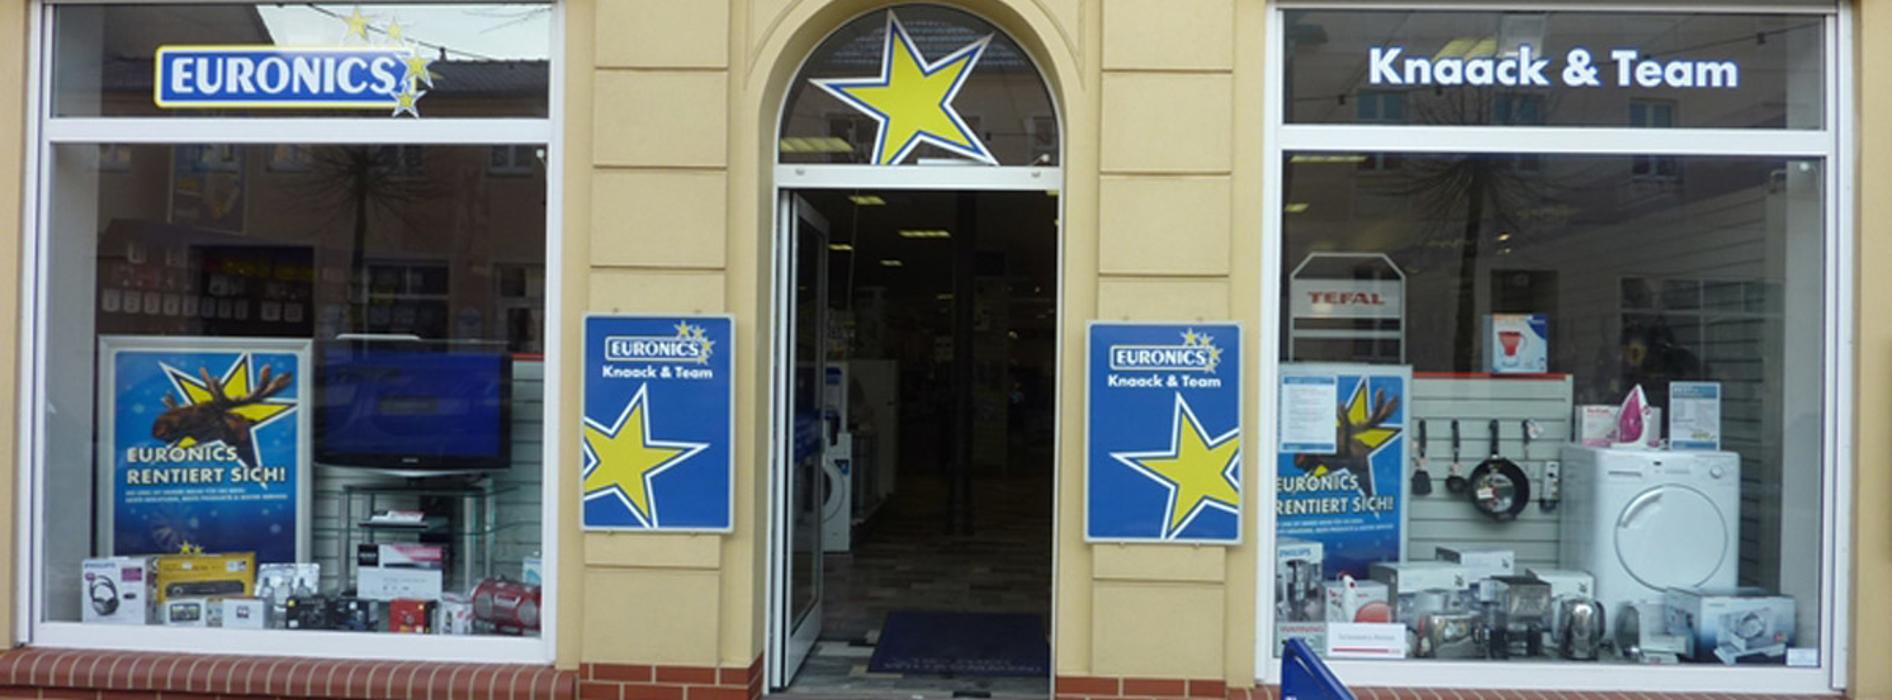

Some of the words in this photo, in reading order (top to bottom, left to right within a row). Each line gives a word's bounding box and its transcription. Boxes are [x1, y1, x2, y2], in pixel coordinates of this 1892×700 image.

[1368, 45, 1550, 86] Knaack
[1561, 48, 1600, 87] &
[1611, 50, 1739, 88] Team
[170, 57, 397, 95] EURONICS
[1307, 291, 1386, 305] TEFAL
[611, 340, 699, 357] EURONICS
[1116, 350, 1207, 365] EURONICS
[602, 365, 657, 378] Knaack
[660, 366, 672, 378] &
[674, 366, 714, 379] Team
[1107, 374, 1163, 387] Knaack
[1166, 374, 1178, 387] &
[1181, 375, 1222, 388] Team
[127, 446, 238, 463] EURONICS
[127, 468, 225, 485] RENTIERT
[231, 466, 287, 483] SICH!
[1275, 497, 1349, 514] RENTIERT
[1352, 495, 1395, 513] SICH!
